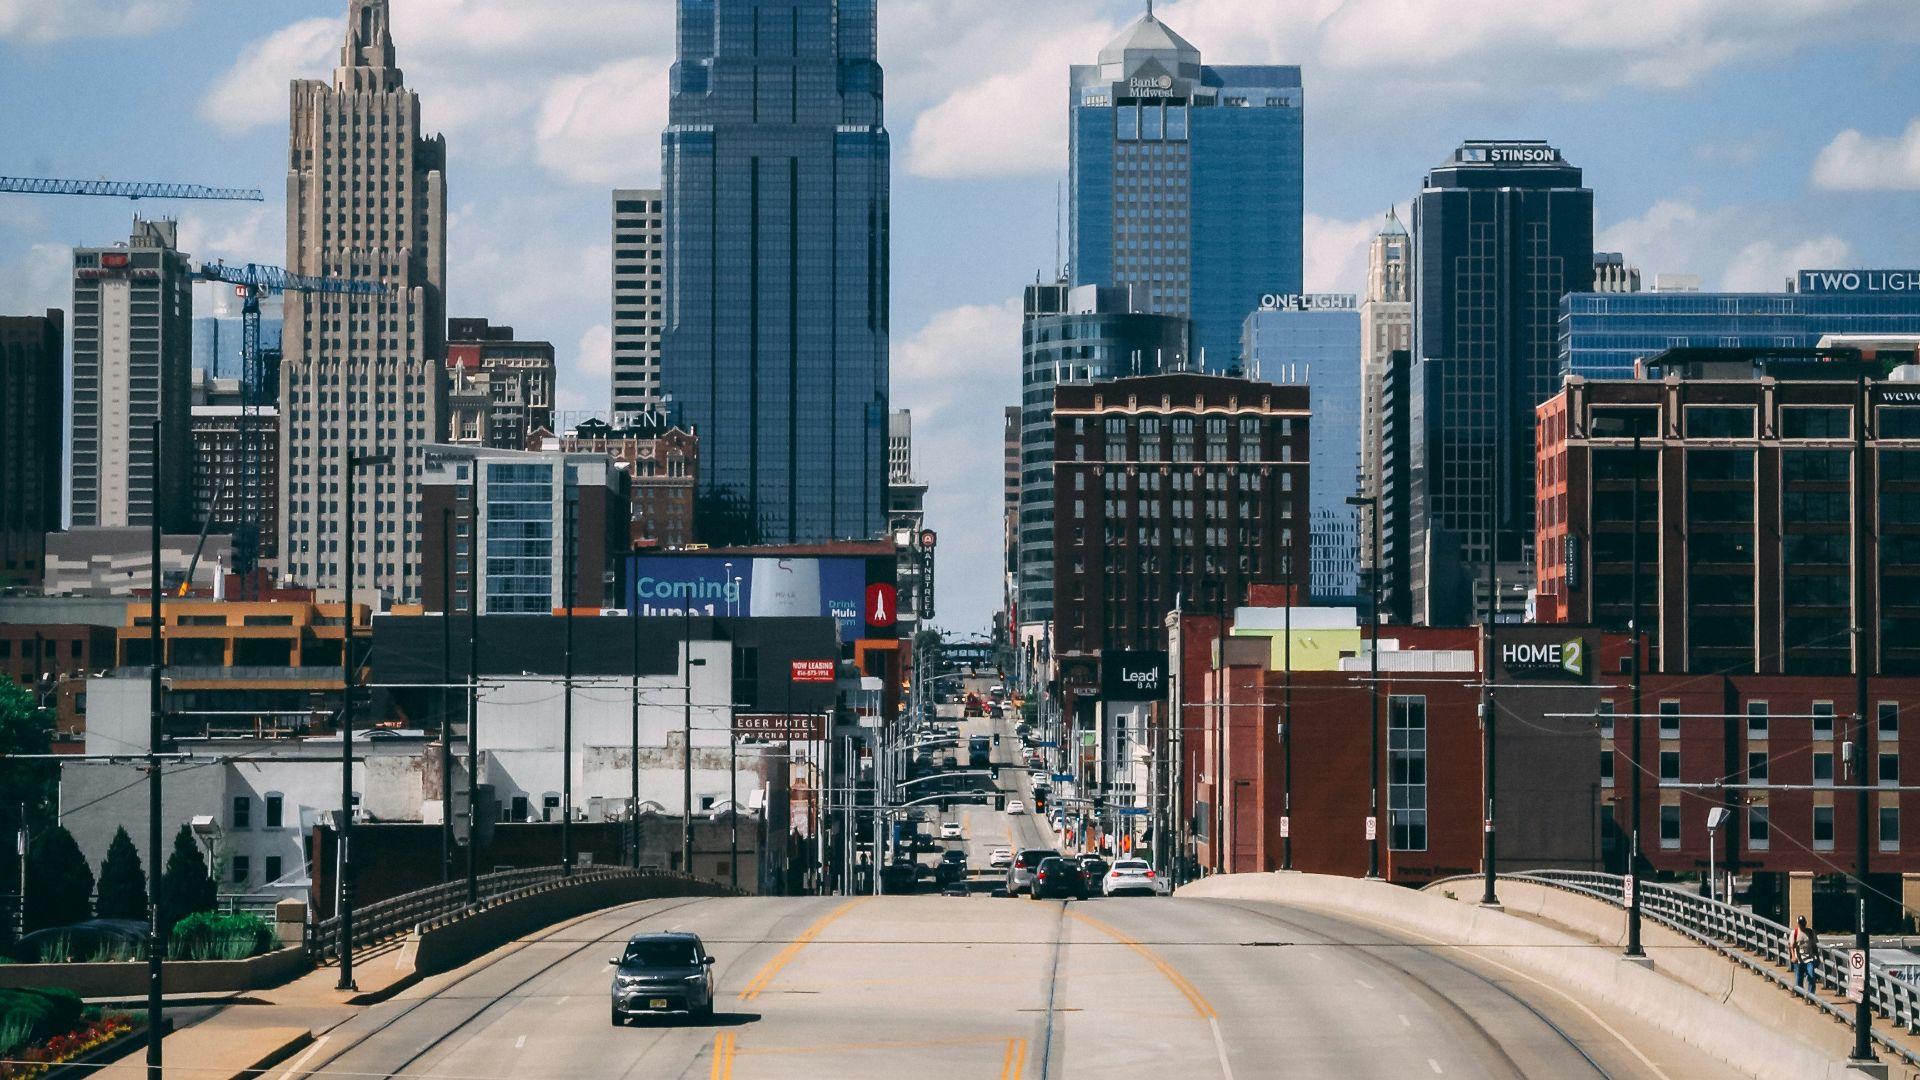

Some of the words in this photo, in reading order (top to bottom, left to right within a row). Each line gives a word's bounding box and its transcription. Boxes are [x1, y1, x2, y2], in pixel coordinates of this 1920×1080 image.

[1130, 77, 1159, 87] Bank
[1130, 88, 1173, 97] Midwest
[1491, 149, 1555, 161] STINSON
[1805, 272, 1861, 291] TWO
[1261, 294, 1298, 308] ONE
[1302, 294, 1353, 308] LIGHT
[549, 410, 672, 428] PRESIDENT
[637, 576, 739, 603] Coming
[829, 600, 856, 609] Drink
[832, 608, 856, 617] Mulu
[1503, 644, 1561, 663] HOME
[1564, 642, 1581, 672] 2
[793, 661, 807, 670] NOW
[808, 661, 833, 670] LEASING
[737, 719, 769, 728] EGER
[775, 719, 815, 728] HOTEL
